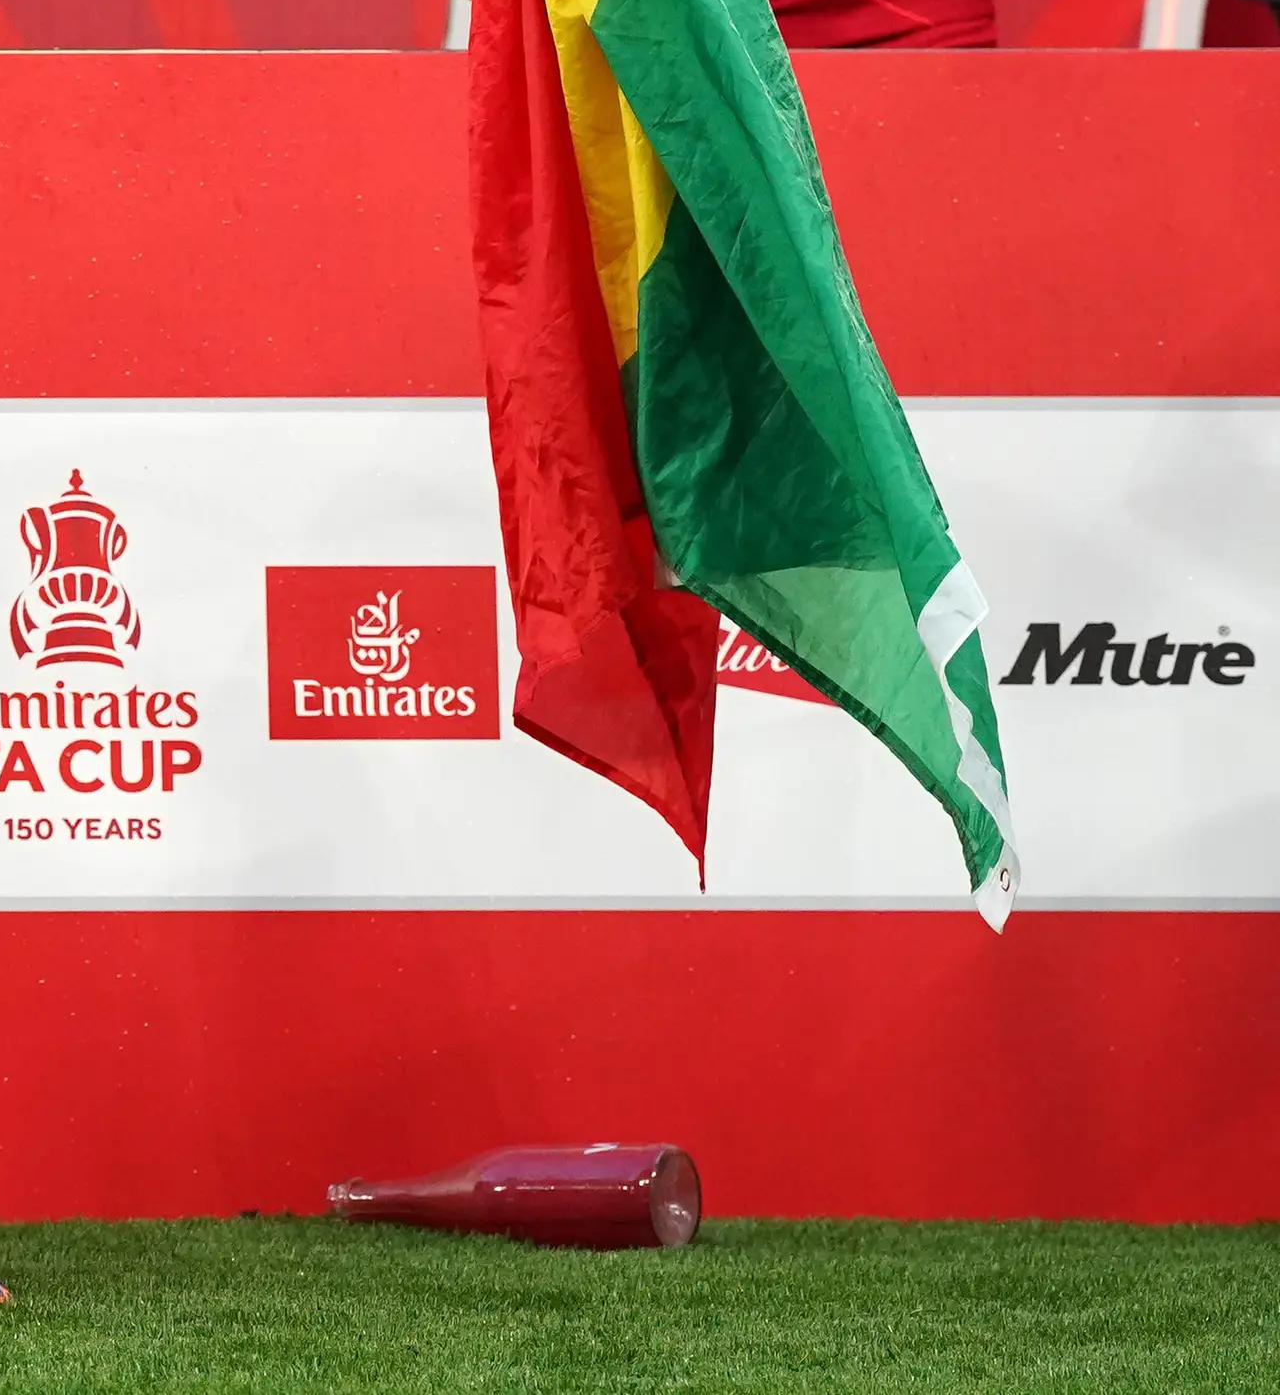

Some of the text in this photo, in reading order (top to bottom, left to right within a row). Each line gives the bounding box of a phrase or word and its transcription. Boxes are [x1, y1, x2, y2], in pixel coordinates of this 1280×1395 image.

[293, 678, 476, 717] Emirates
[59, 739, 202, 793] CUP
[4, 818, 162, 840] 150 YEARS
